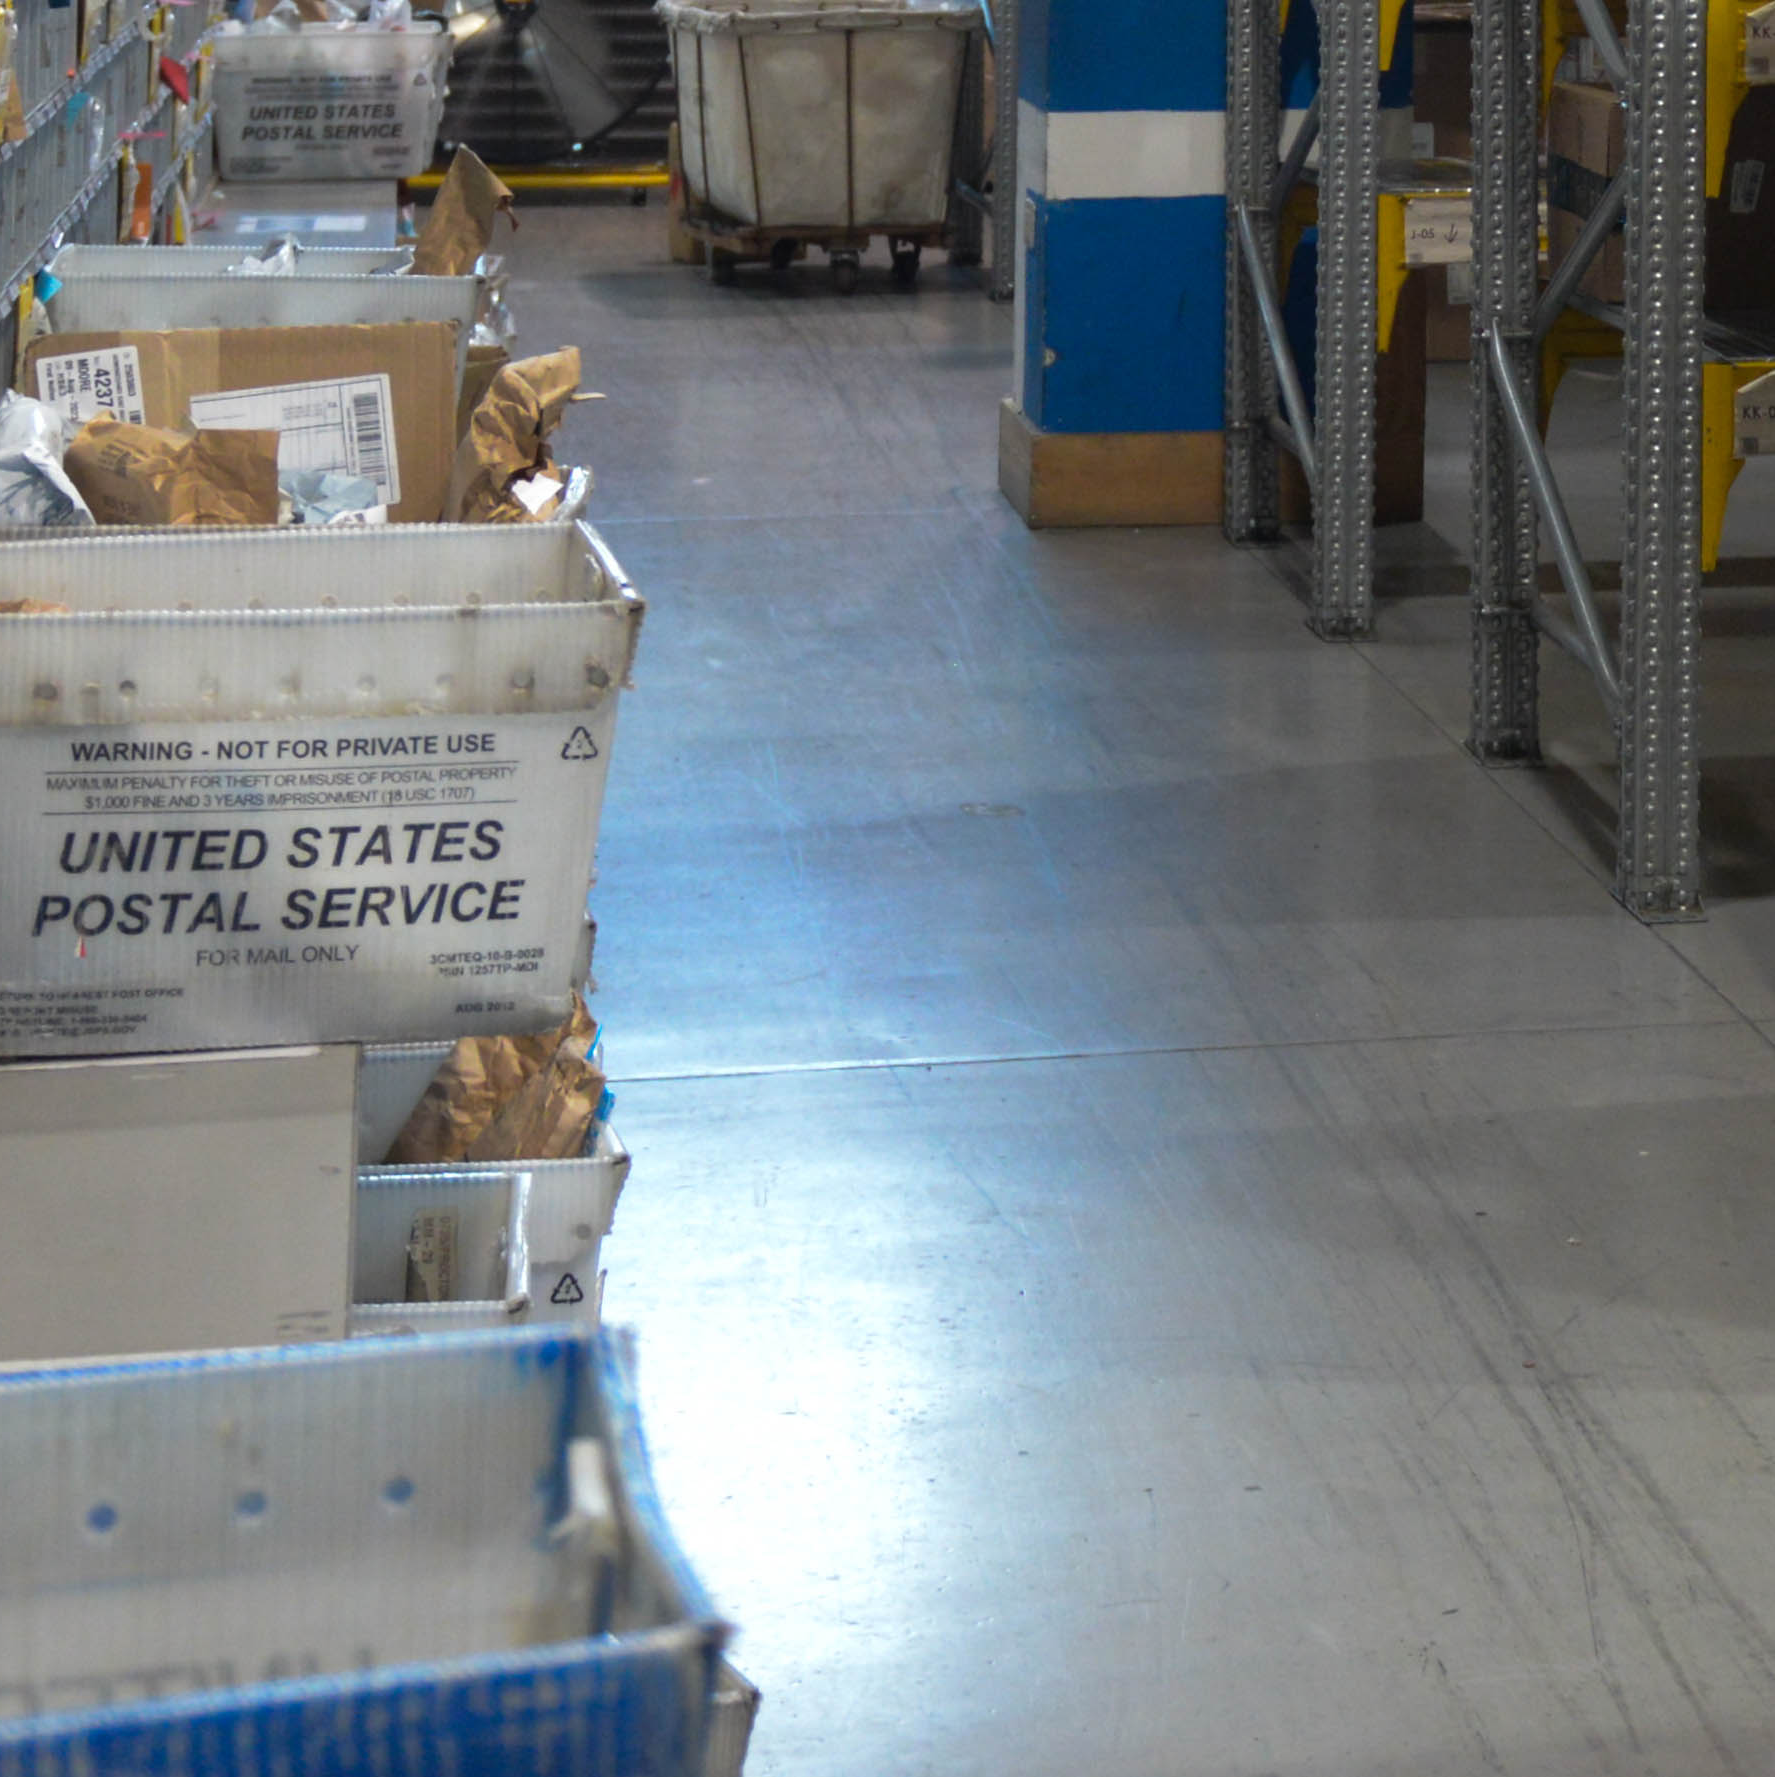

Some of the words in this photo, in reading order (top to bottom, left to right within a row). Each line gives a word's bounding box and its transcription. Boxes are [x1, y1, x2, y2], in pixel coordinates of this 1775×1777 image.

[250, 105, 318, 121] UNITED
[325, 103, 396, 120] STATES
[242, 125, 316, 141] POSTAL
[322, 123, 403, 140] SERVICE
[77, 358, 92, 392] MOORE
[94, 368, 114, 407] 4237
[72, 741, 193, 762] WARNING
[217, 740, 268, 760] NOT
[277, 739, 329, 759] FOR
[336, 735, 439, 757] PRIVATE
[447, 733, 496, 753] USE
[46, 777, 119, 791] MAXIMUM
[120, 775, 188, 790] PENALTY
[190, 775, 221, 789] FOR
[226, 774, 270, 788] THEFT
[274, 774, 297, 786] OR
[300, 773, 354, 786] MISUSE
[358, 772, 377, 784] OF
[381, 770, 436, 784] POSTAL
[439, 767, 518, 781] PROPERTY
[133, 795, 168, 808] FINE
[169, 794, 201, 807] AND
[203, 795, 213, 807] 3
[214, 793, 266, 806] YEARS
[267, 791, 379, 807] IMPRISONMENT
[405, 788, 436, 802] USC
[59, 829, 268, 874] UNITED
[287, 821, 505, 869] STATES
[31, 891, 261, 937] POSTAL
[281, 880, 526, 930] SERVICE
[196, 949, 239, 967] FOR
[247, 948, 294, 965] MAIL
[301, 945, 359, 963] ONLY
